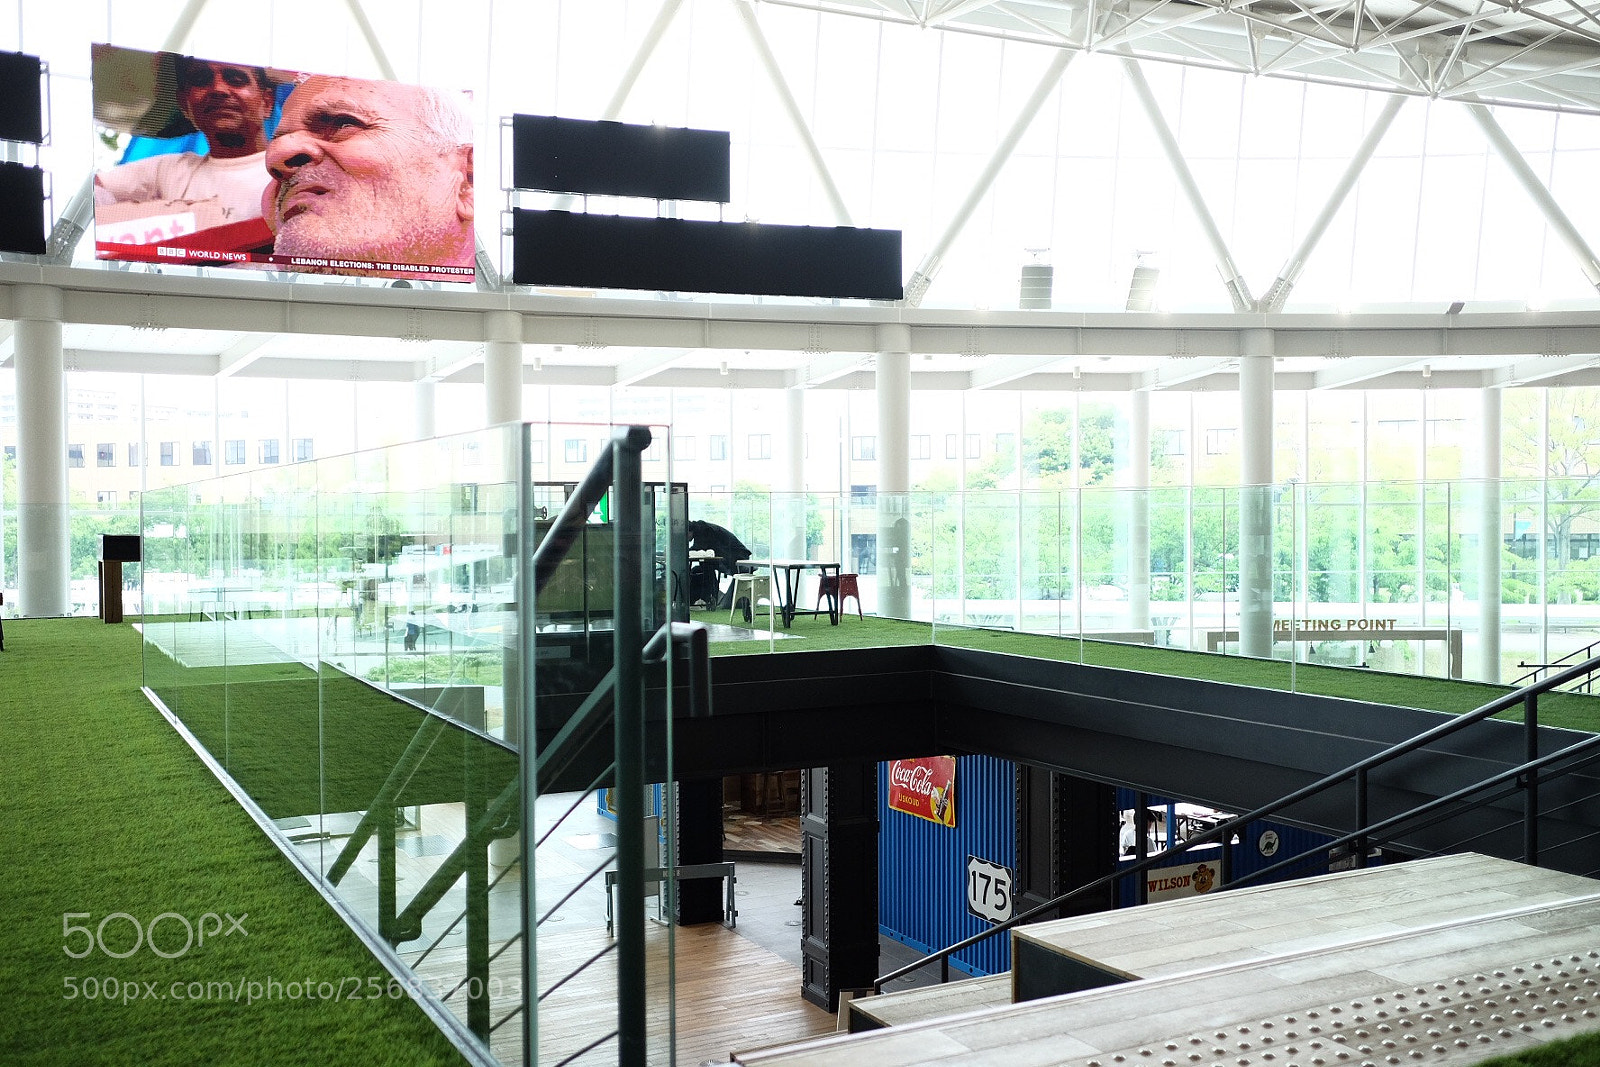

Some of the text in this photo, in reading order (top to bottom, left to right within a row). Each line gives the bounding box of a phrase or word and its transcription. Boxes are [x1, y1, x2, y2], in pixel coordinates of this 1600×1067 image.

[158, 247, 247, 261] BBC WORLD NEWS
[291, 257, 328, 267] LEBANON
[330, 259, 374, 270] ELECTIONS:
[393, 264, 429, 273] DISABLED
[431, 266, 474, 275] PROTESTER
[1347, 619, 1397, 631] POINT
[971, 870, 1007, 911] 175
[1147, 875, 1191, 893] WILSON
